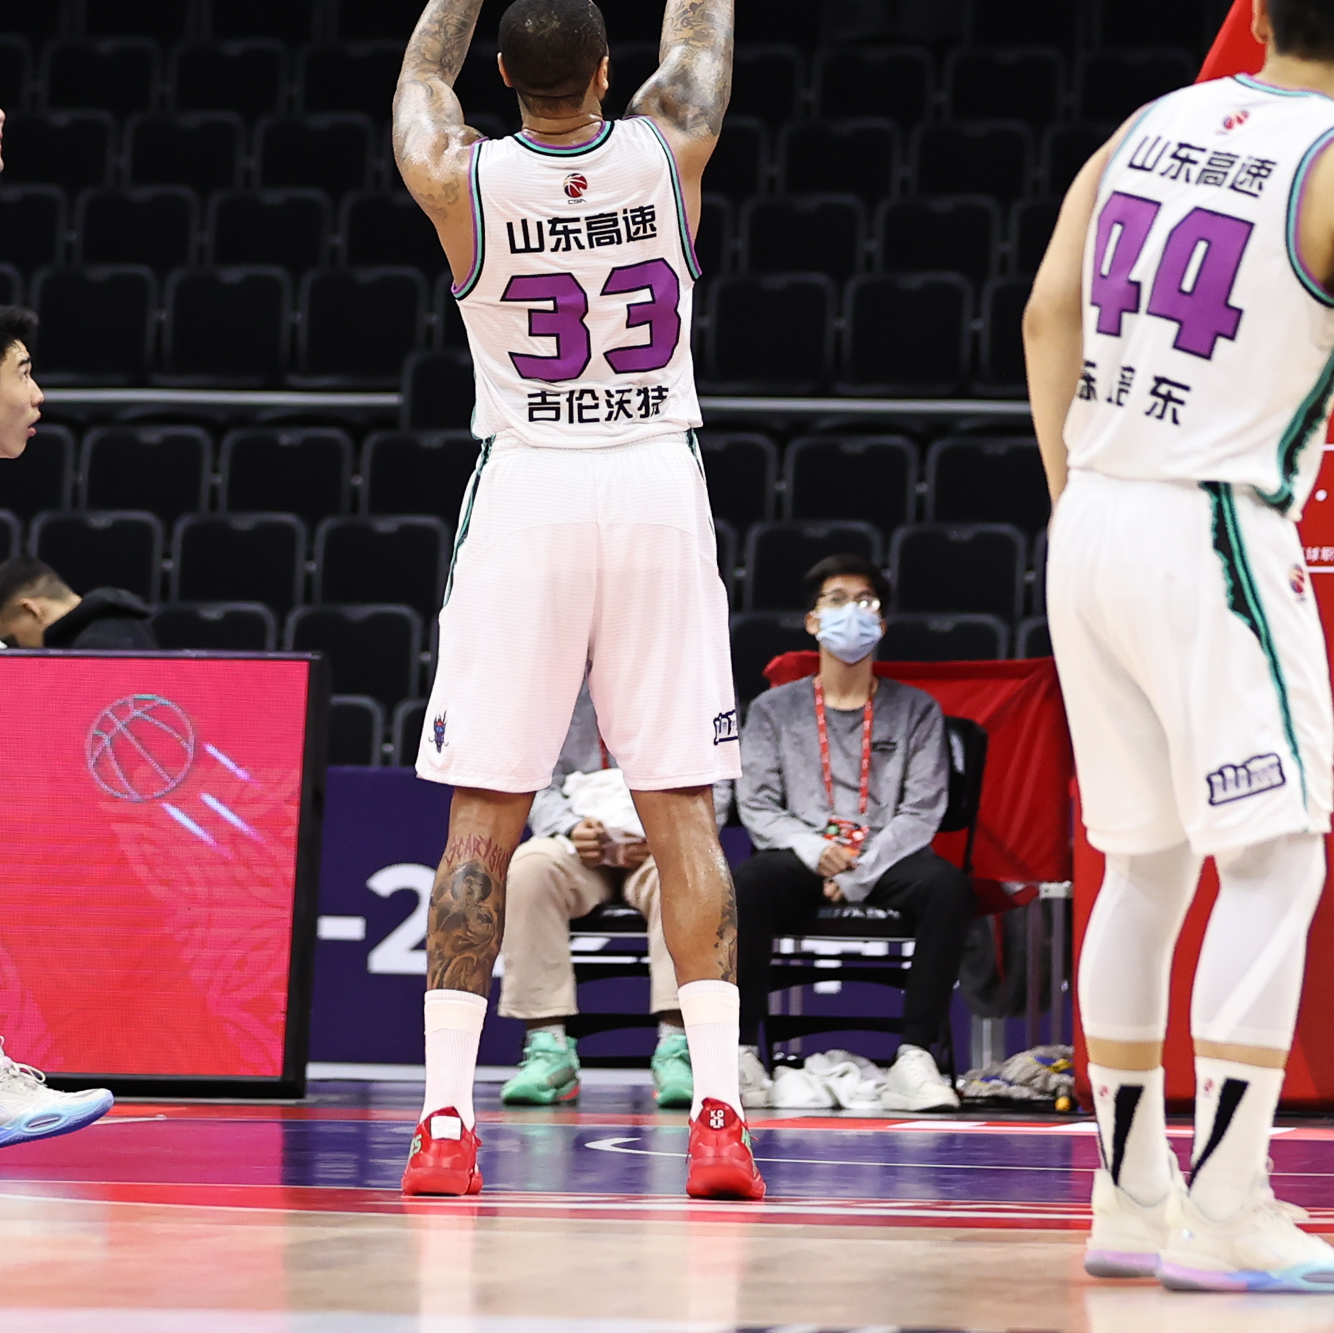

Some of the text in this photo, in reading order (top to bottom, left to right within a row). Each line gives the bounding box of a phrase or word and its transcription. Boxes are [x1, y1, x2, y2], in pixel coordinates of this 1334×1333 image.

[1127, 134, 1278, 198] 山东高速
[505, 204, 658, 254] 山东高速
[1090, 190, 1255, 361] 44
[499, 257, 682, 384] 33
[526, 384, 670, 424] 吉伦沃特
